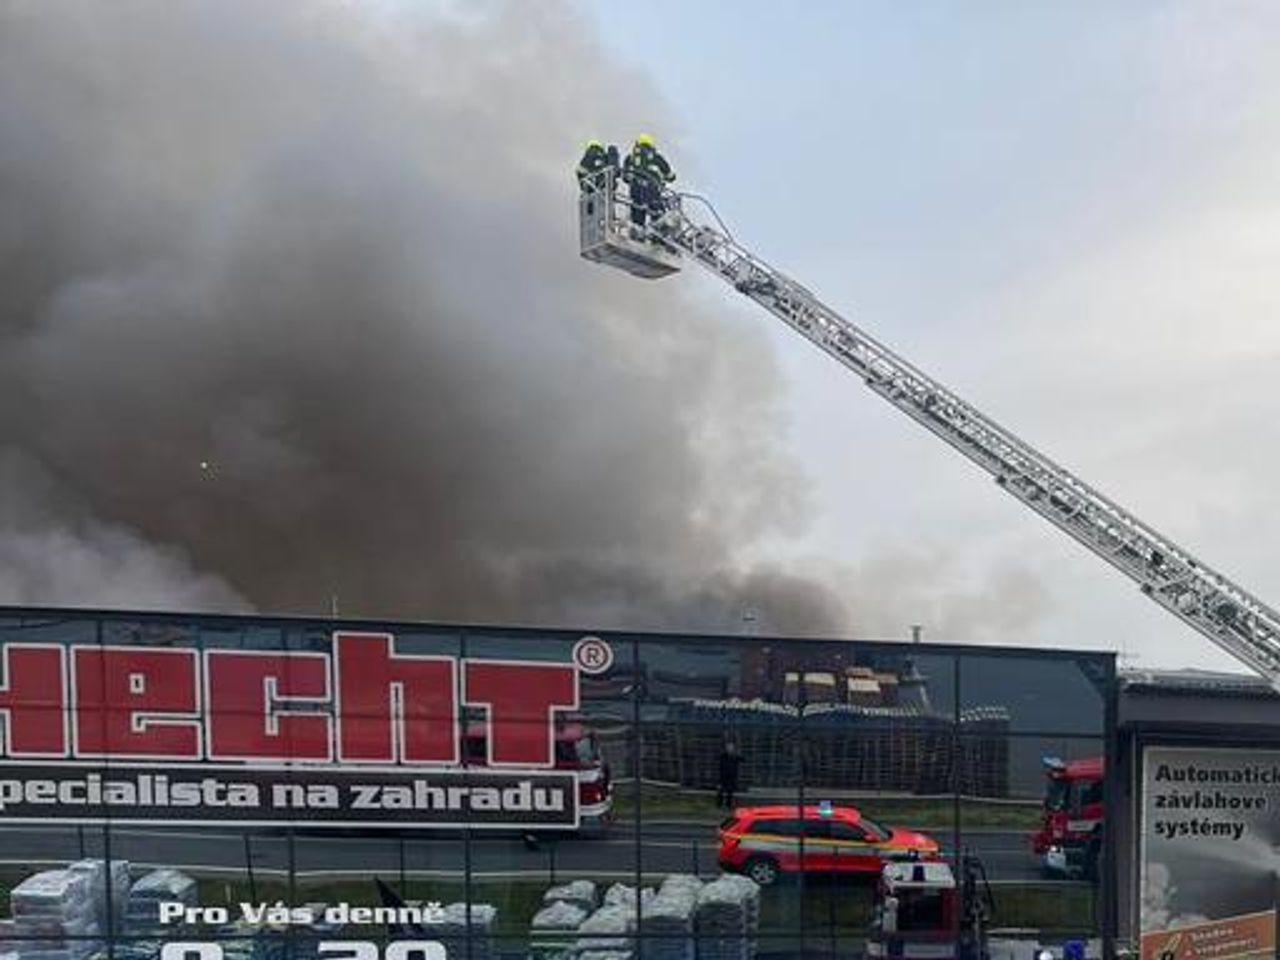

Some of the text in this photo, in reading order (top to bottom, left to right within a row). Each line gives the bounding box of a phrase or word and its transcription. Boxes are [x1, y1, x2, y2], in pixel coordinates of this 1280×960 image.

[272, 784, 339, 808] na
[350, 780, 565, 812] zahradu
[1154, 816, 1245, 841] systémy
[159, 901, 446, 924] Pro Vás denně
